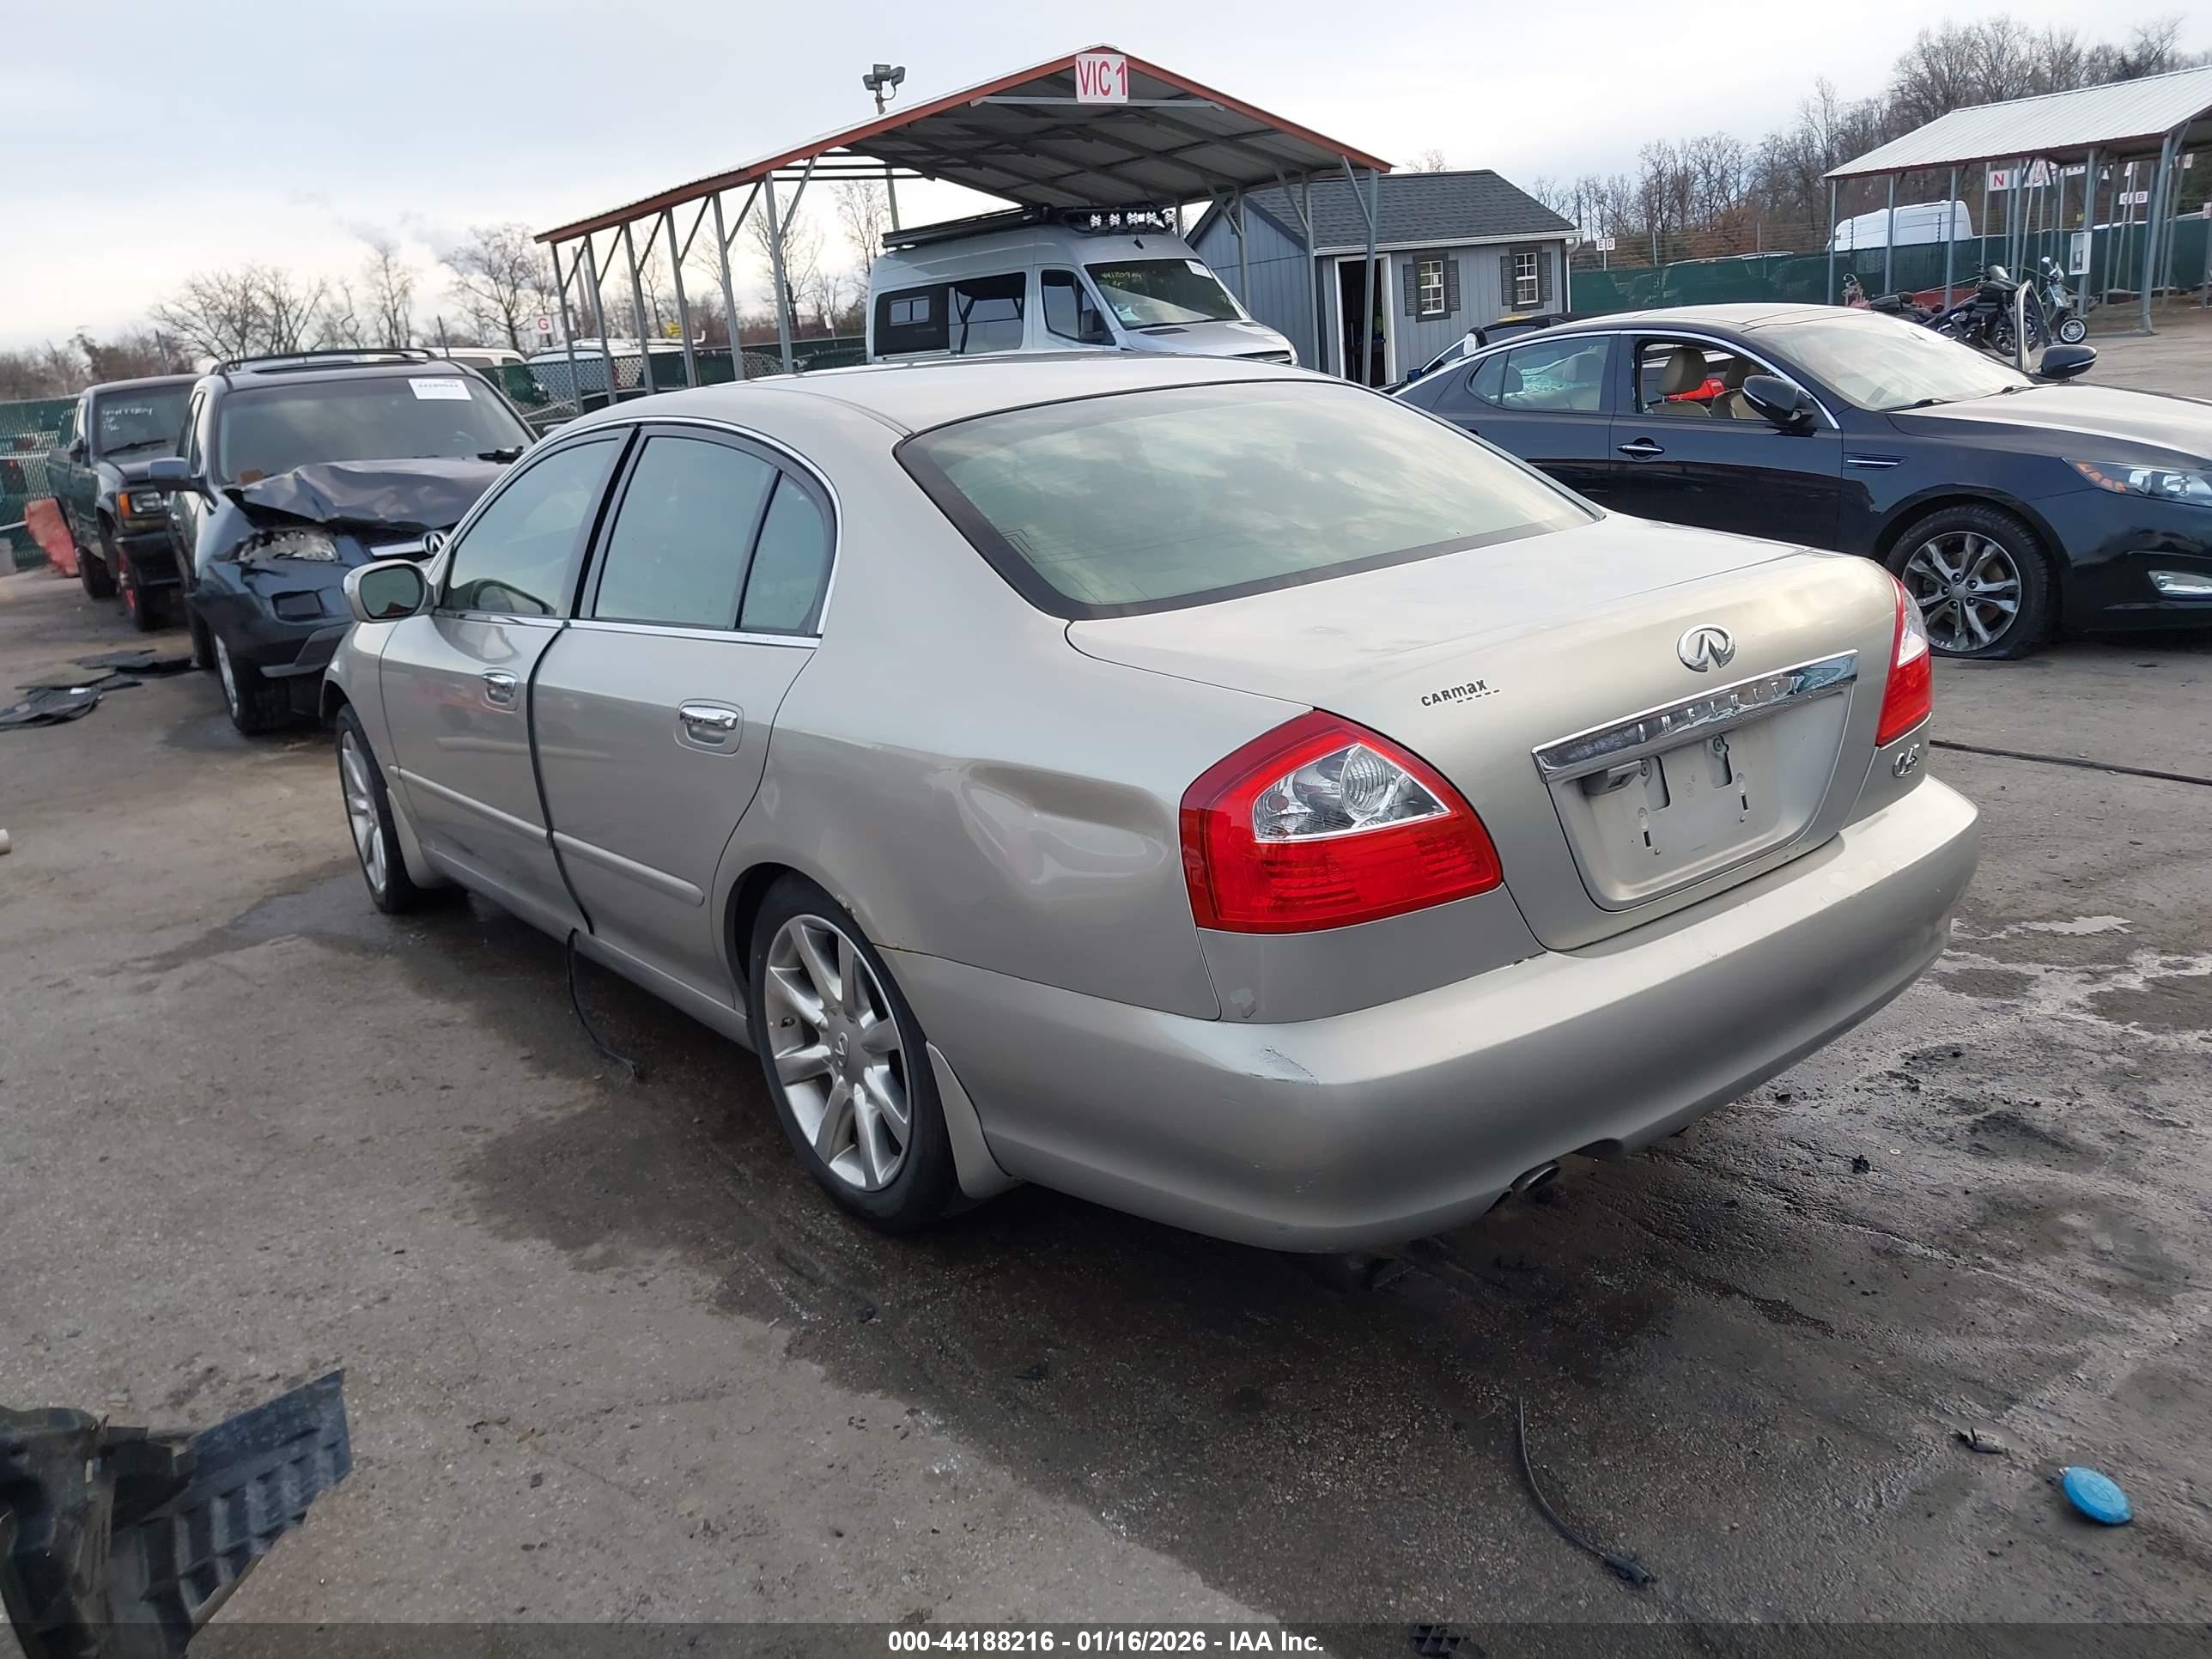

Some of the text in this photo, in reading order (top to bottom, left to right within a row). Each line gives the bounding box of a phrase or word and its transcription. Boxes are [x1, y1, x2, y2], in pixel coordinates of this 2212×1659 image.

[1077, 60, 1127, 96] VIC 1
[1993, 173, 2004, 187] N
[1598, 240, 1604, 249] E
[1608, 239, 1613, 248] D
[538, 318, 549, 331] G
[1638, 676, 1798, 743] INFINITI
